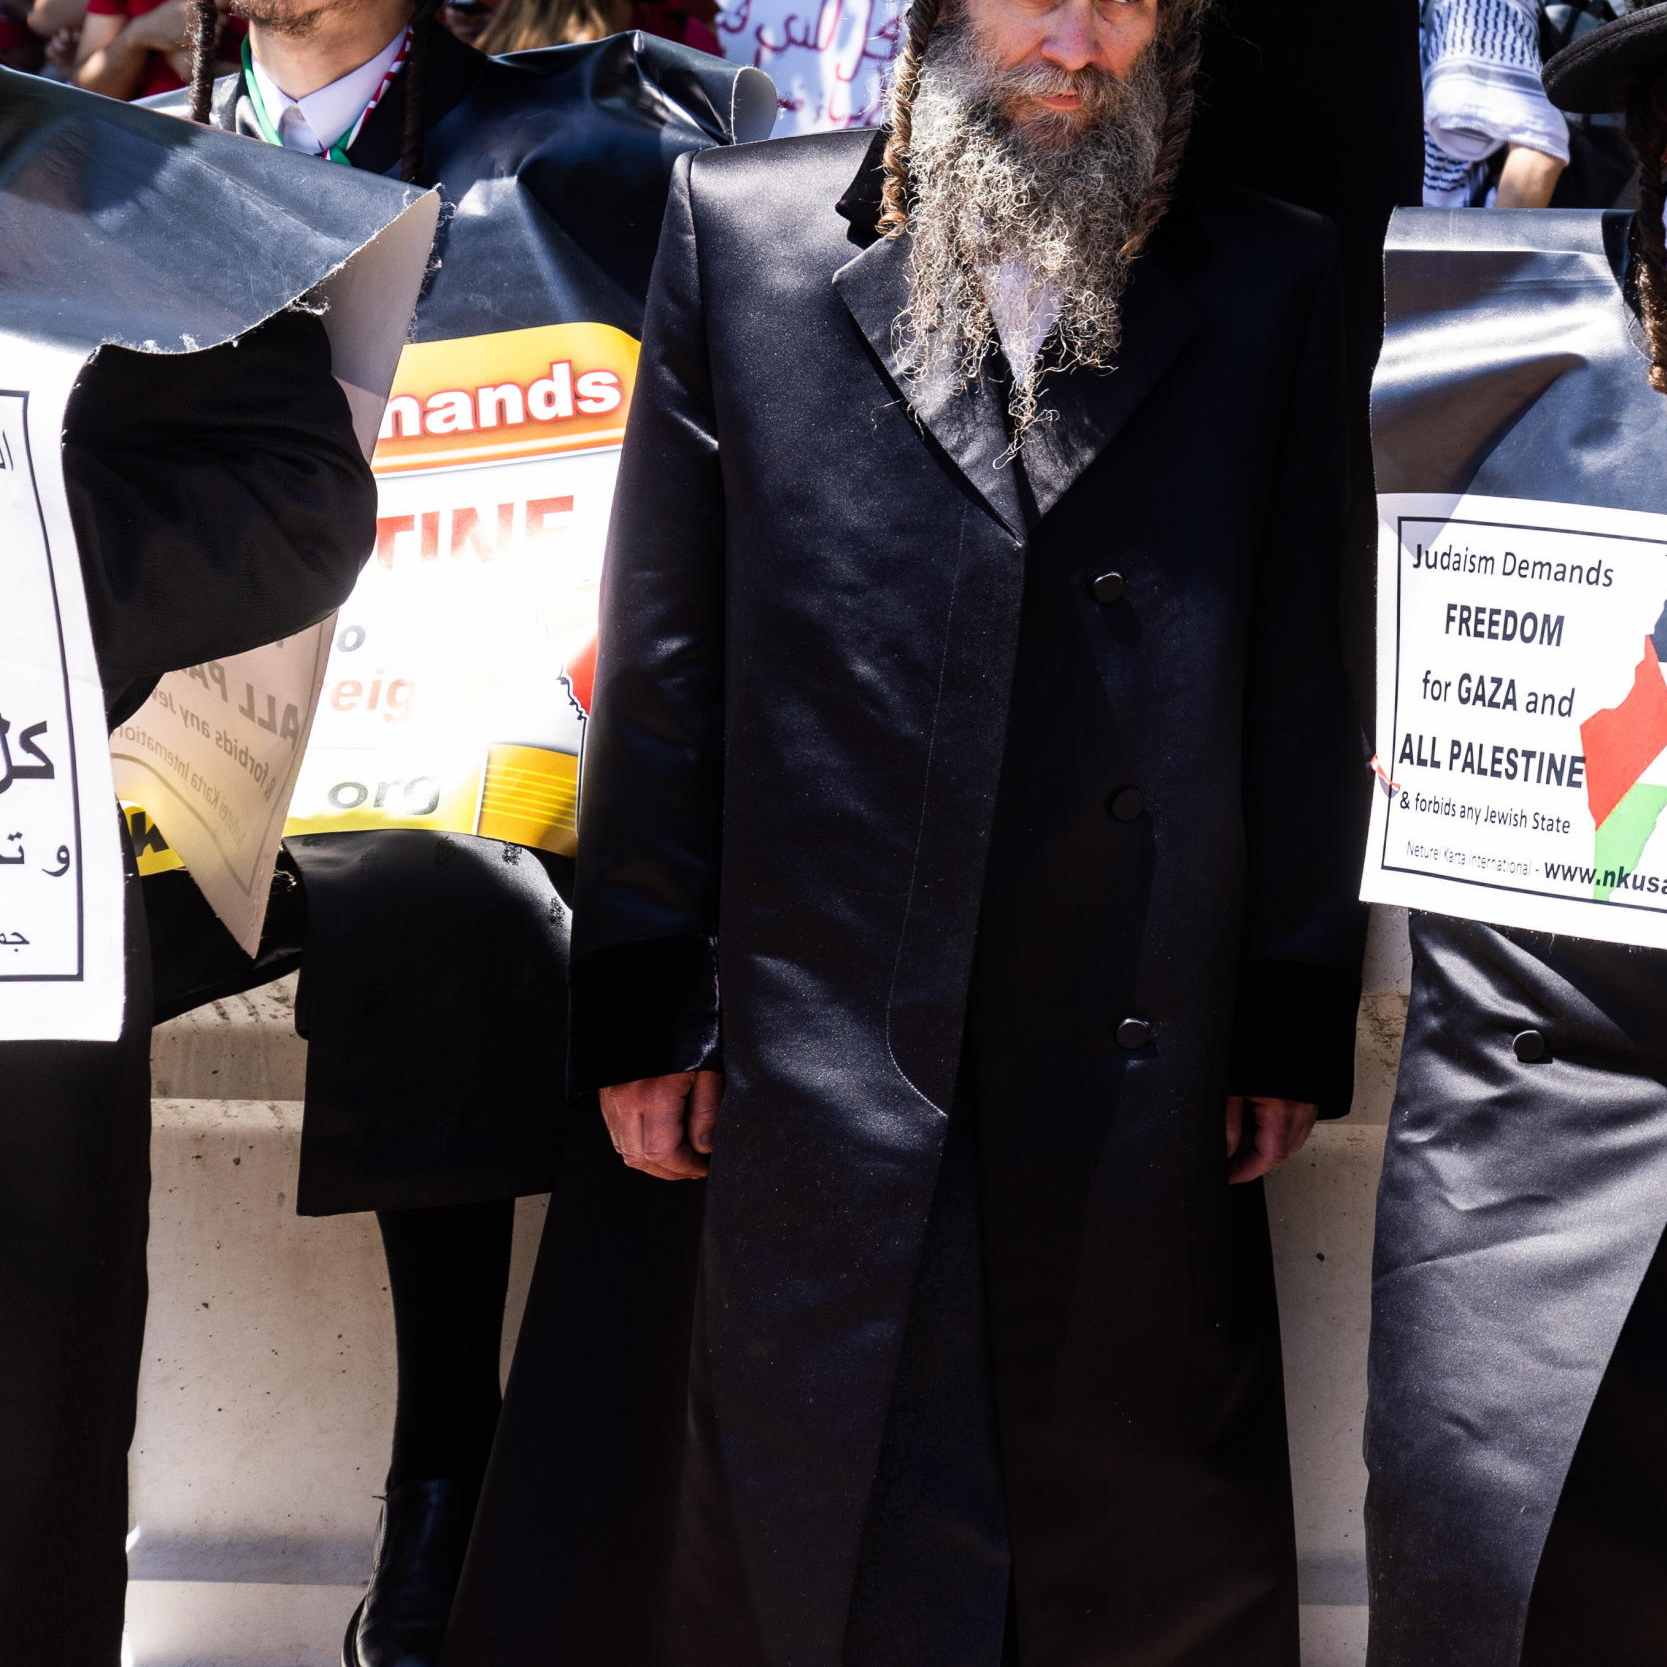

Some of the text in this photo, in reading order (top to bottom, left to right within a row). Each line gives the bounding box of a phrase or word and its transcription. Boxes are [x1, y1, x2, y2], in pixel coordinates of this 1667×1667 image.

[1413, 544, 1614, 587] Judaism Demands
[1445, 603, 1565, 647] FREEDOM
[1422, 670, 1576, 717] for GAZA and
[1398, 733, 1587, 789] ALL PALESTINE
[328, 776, 441, 816] org
[1400, 791, 1571, 834] & forbids any Jewish State
[1443, 847, 1467, 866] Karta
